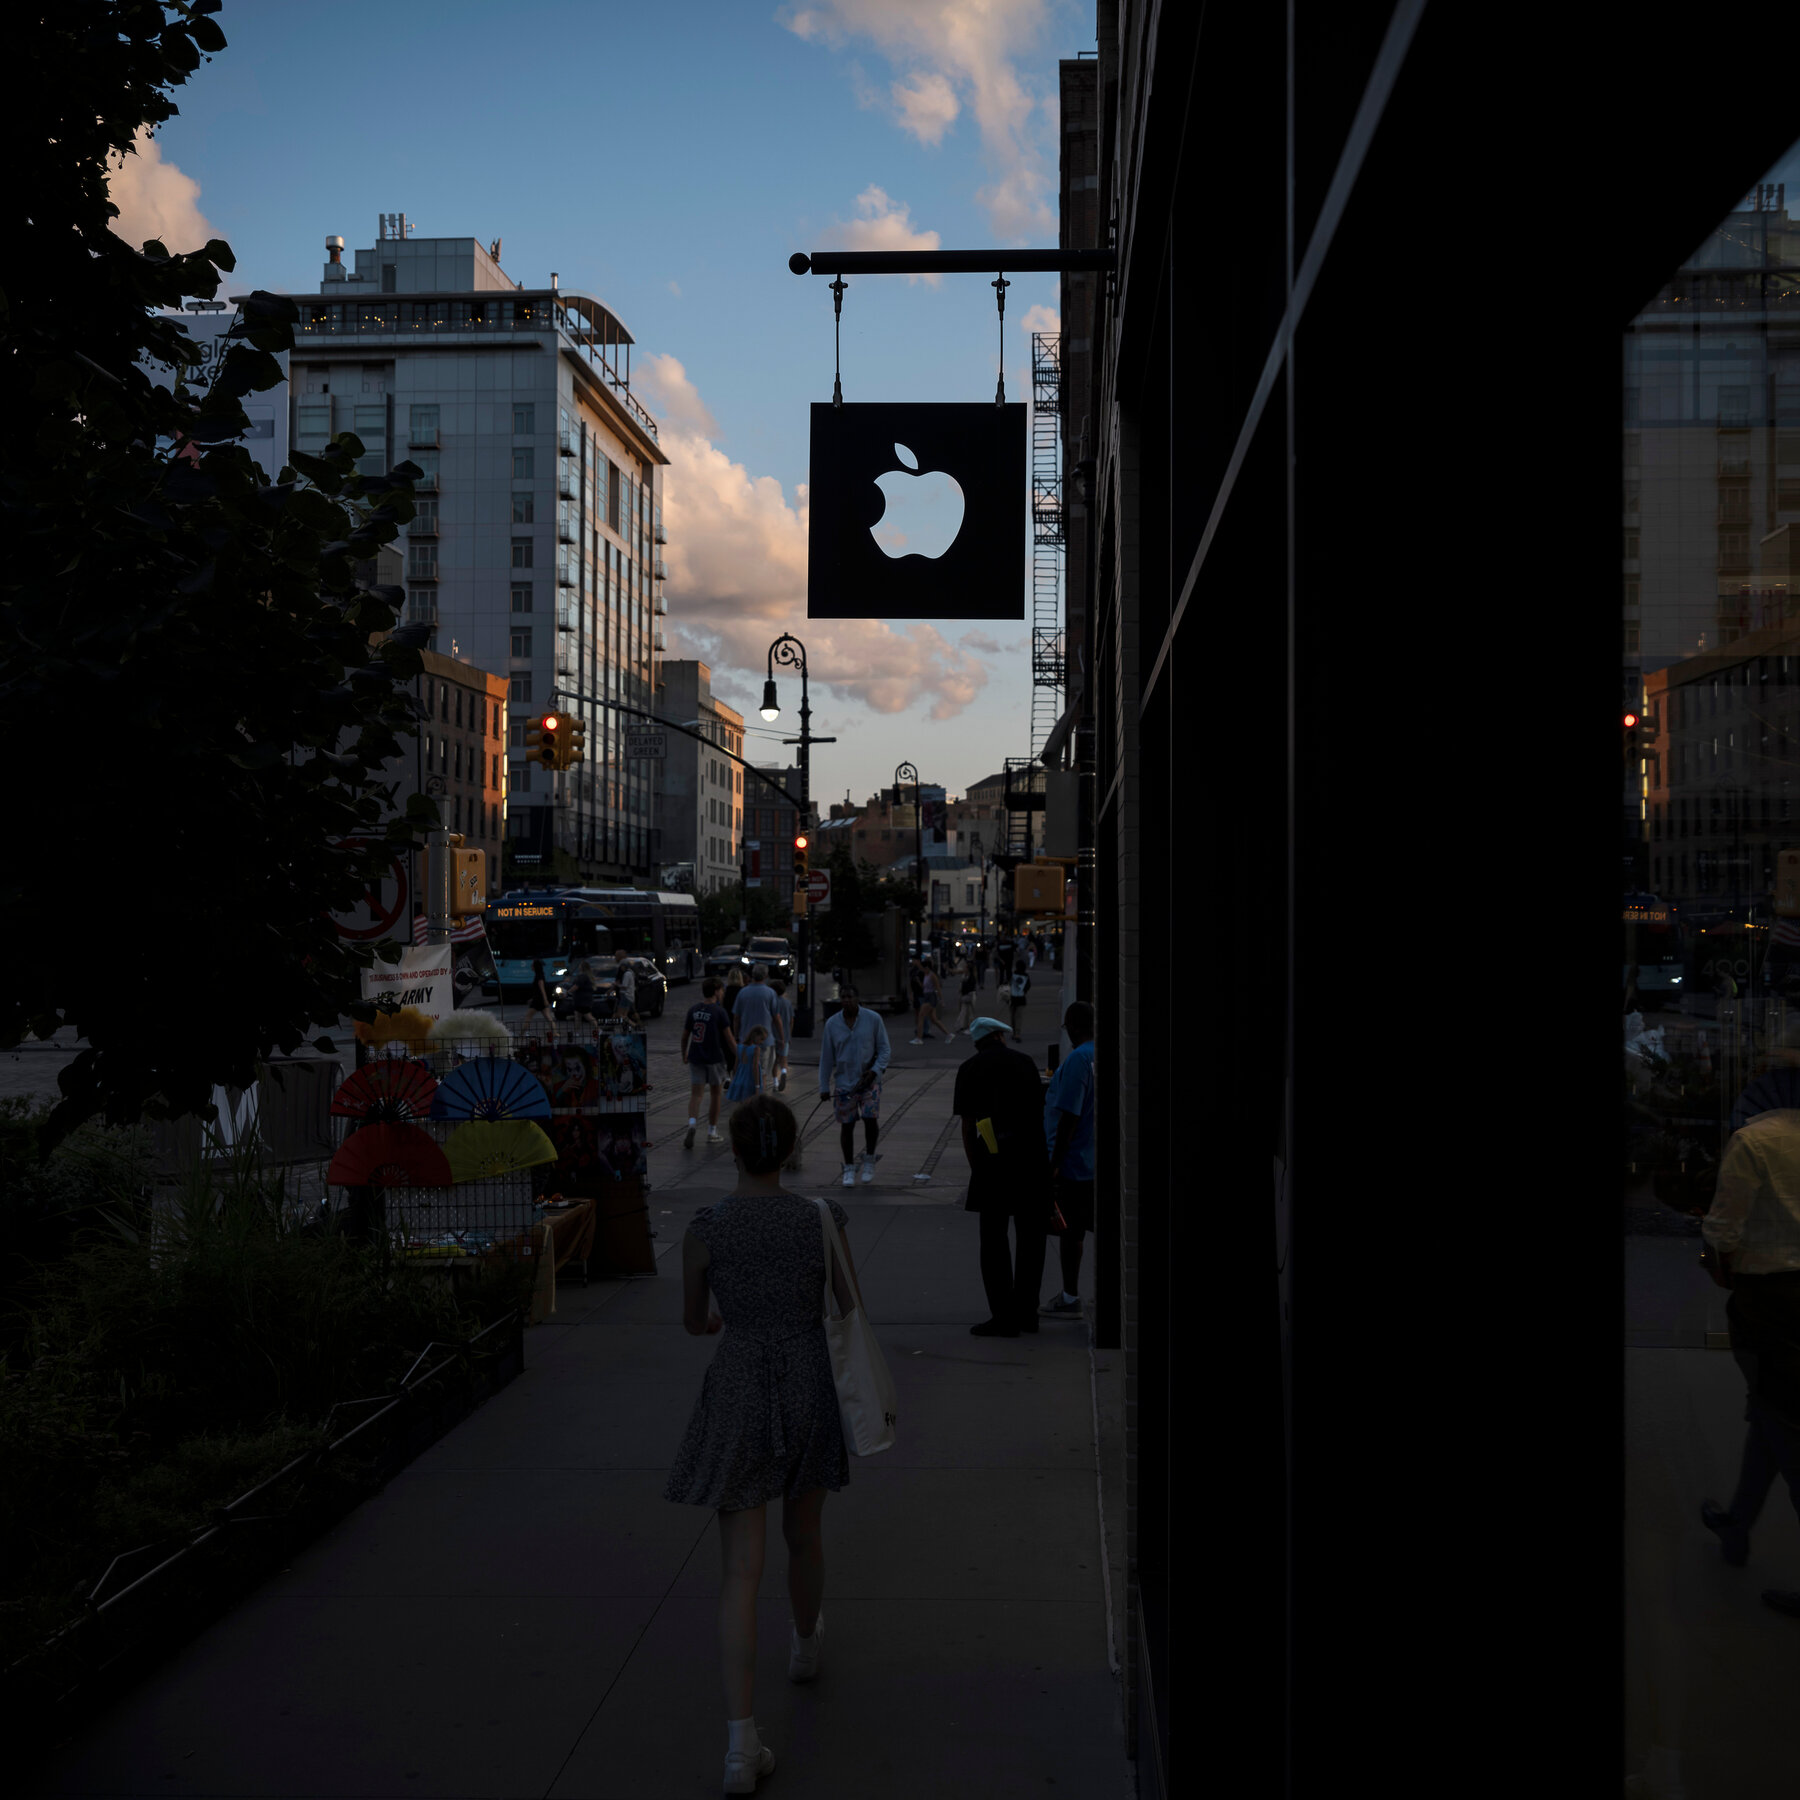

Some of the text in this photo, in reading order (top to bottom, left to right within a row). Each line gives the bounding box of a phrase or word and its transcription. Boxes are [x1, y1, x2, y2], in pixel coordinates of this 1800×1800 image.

[629, 737, 663, 746] DELAYED
[633, 747, 659, 755] GREEN
[498, 907, 554, 917] NOT IN SERVICE
[409, 971, 418, 979] AND
[419, 969, 439, 978] OPERATED
[440, 968, 448, 976] BY
[400, 987, 433, 1006] ARMY
[692, 1022, 706, 1042] 3
